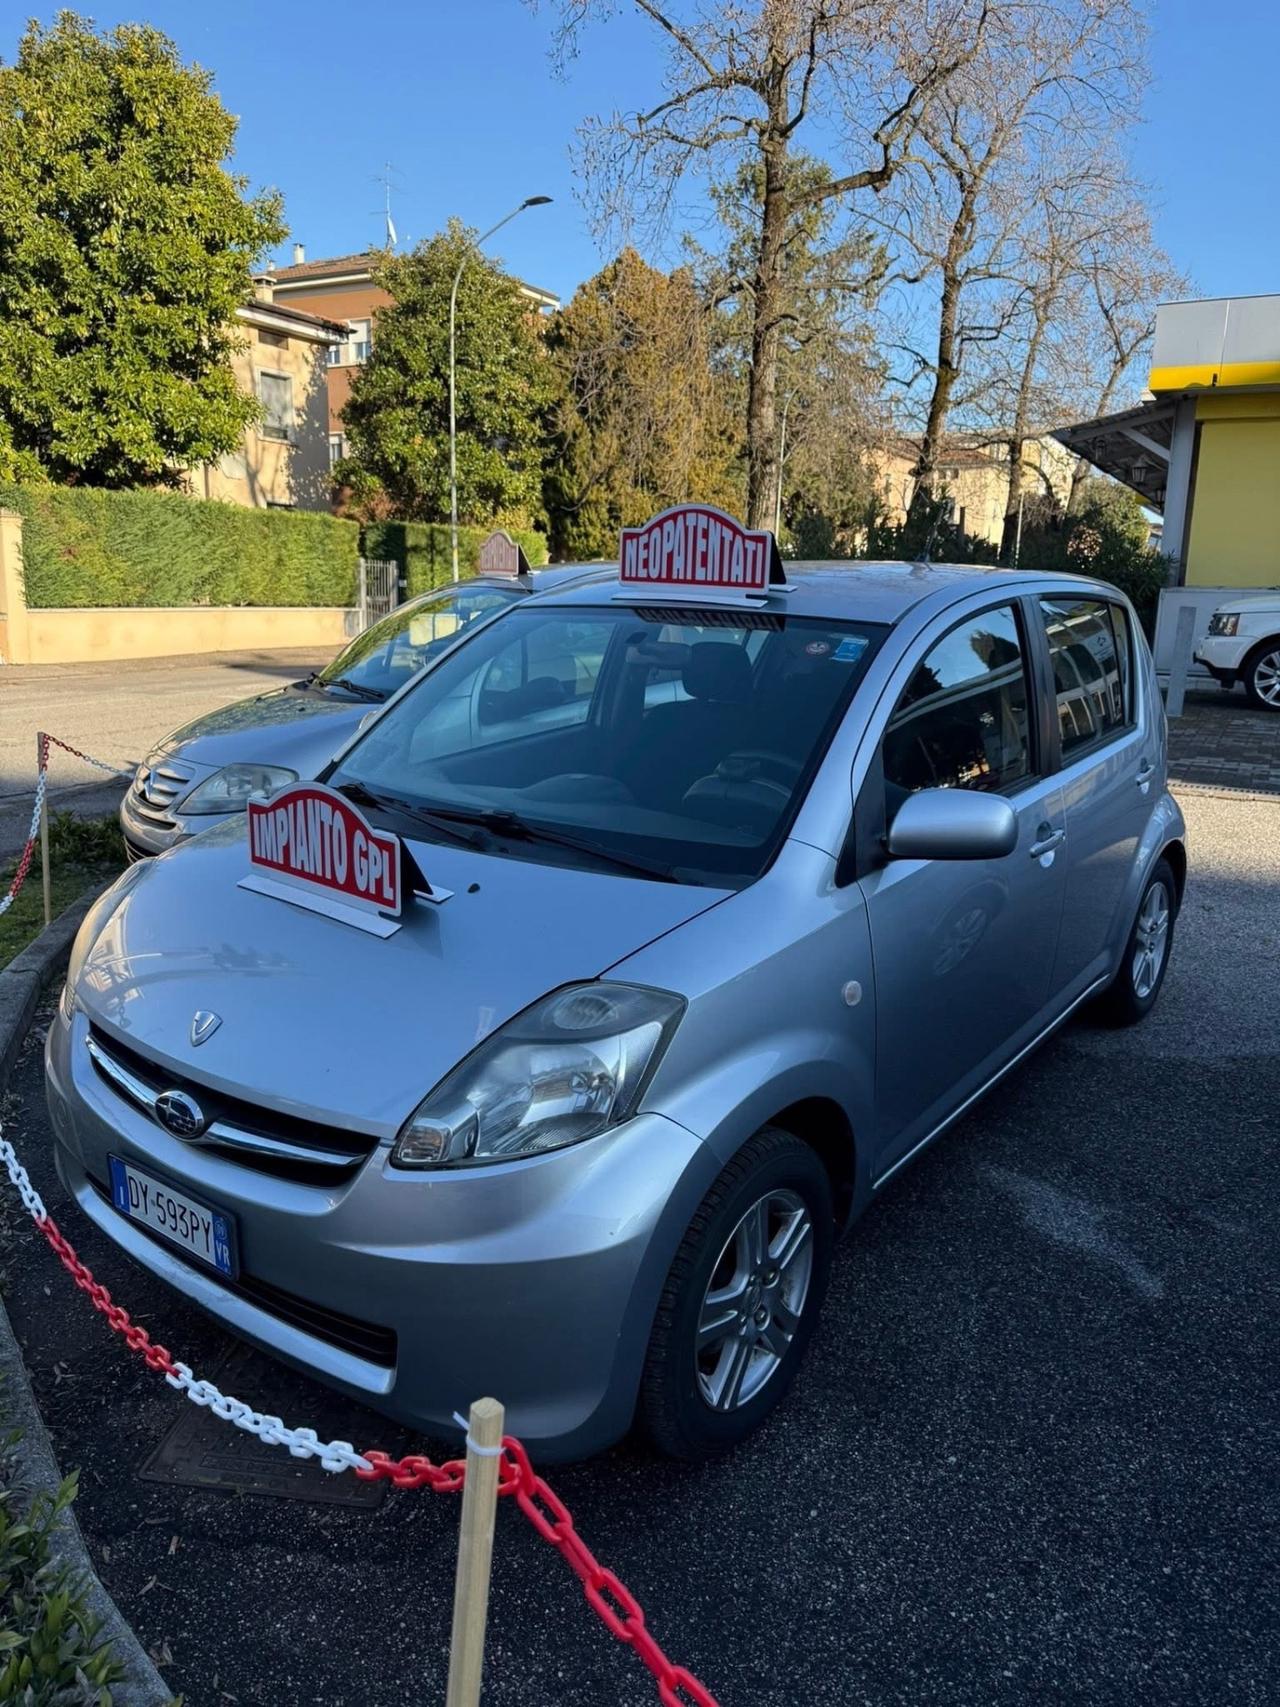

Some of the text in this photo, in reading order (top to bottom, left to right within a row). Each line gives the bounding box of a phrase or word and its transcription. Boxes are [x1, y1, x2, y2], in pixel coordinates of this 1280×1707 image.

[625, 513, 763, 584] NEOPATENTATI
[253, 799, 394, 900] IMPIANTO GPL
[215, 1242, 231, 1266] VR
